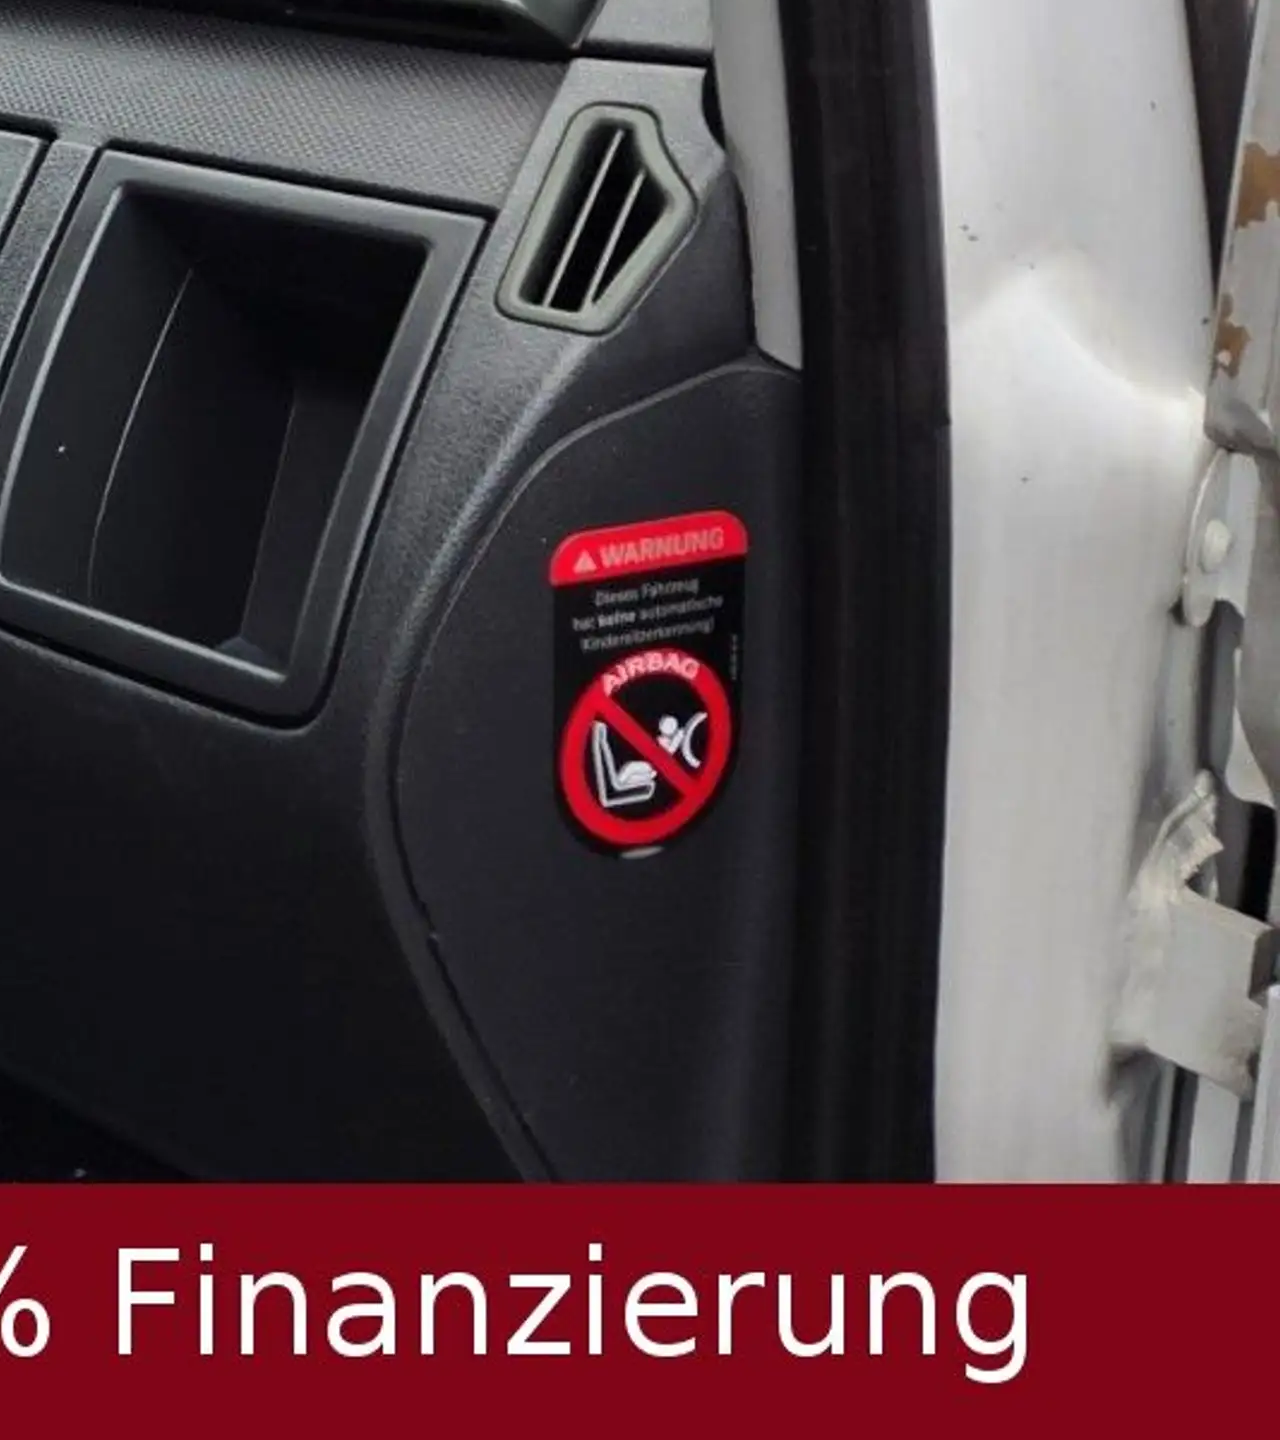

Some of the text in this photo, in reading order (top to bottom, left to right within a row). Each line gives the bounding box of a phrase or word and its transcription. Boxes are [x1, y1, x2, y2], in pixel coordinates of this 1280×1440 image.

[600, 528, 724, 568] WARNUNG
[598, 610, 636, 628] keine
[601, 650, 702, 695] AIRBAG
